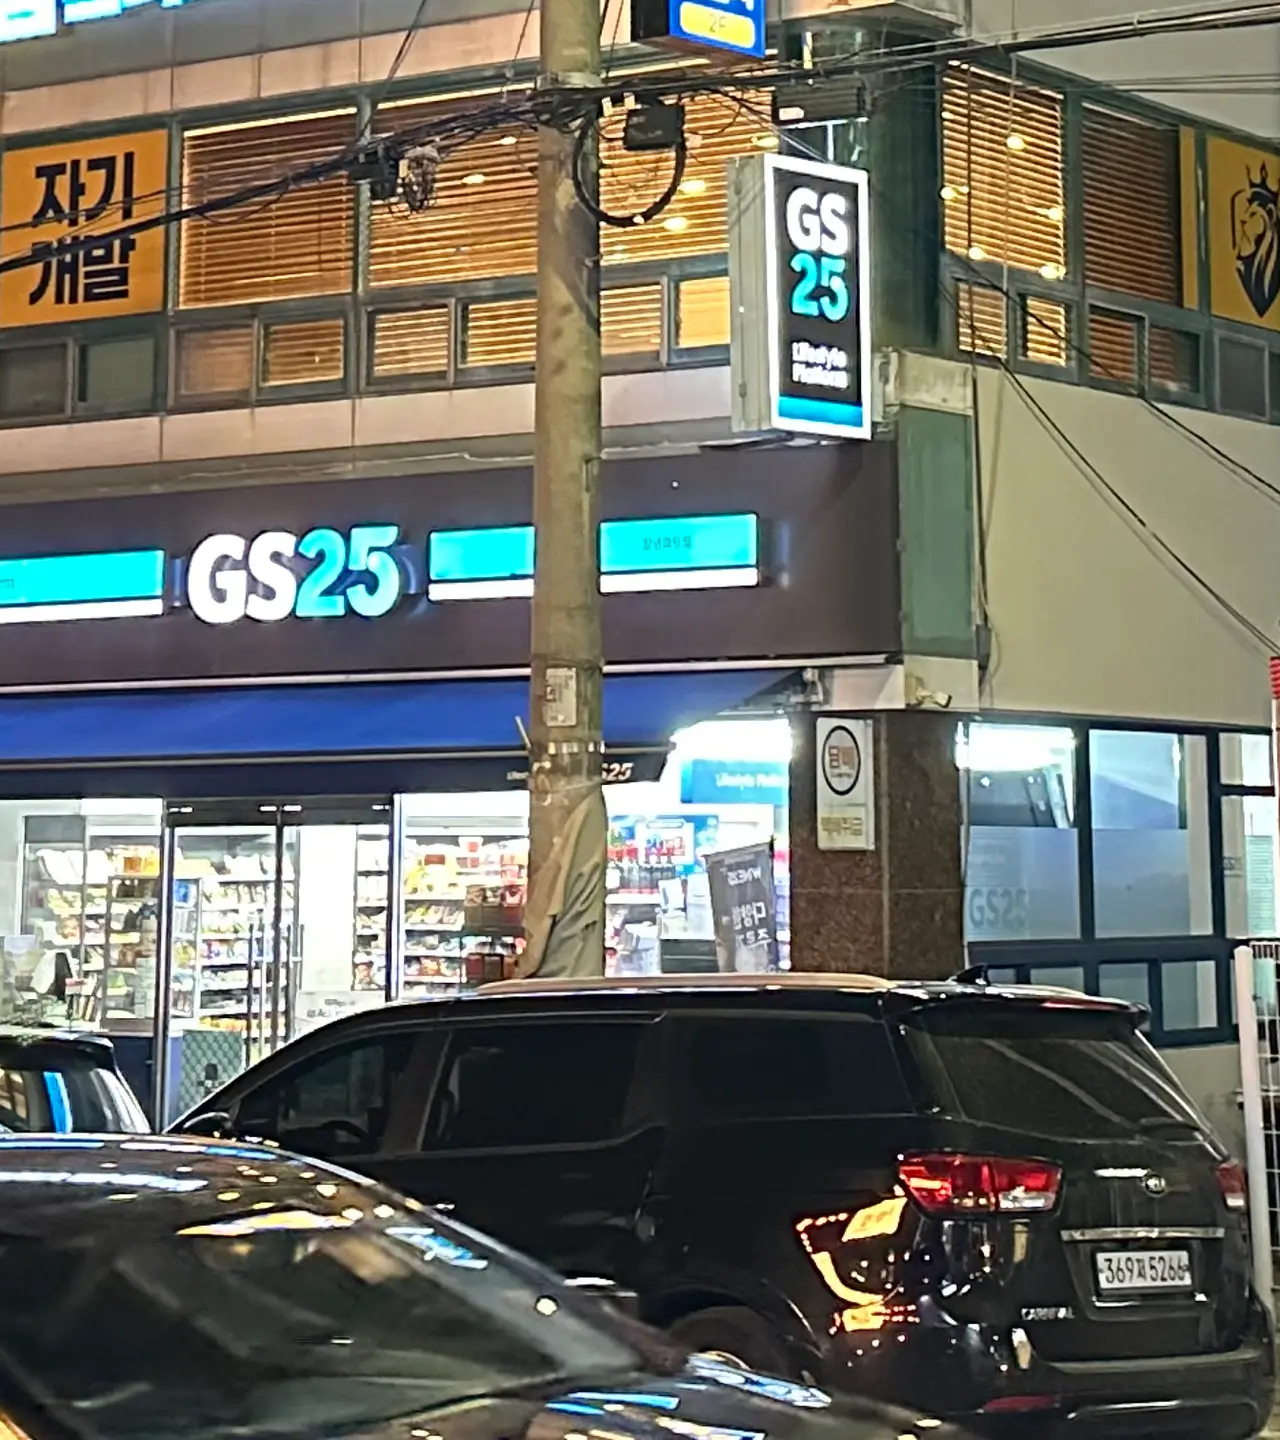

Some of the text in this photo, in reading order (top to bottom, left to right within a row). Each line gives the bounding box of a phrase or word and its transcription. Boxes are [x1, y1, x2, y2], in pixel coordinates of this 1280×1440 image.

[32, 151, 136, 227] 자기
[786, 187, 849, 255] GS
[29, 235, 136, 306] 개발
[789, 252, 849, 321] 25
[187, 524, 400, 624] GS25
